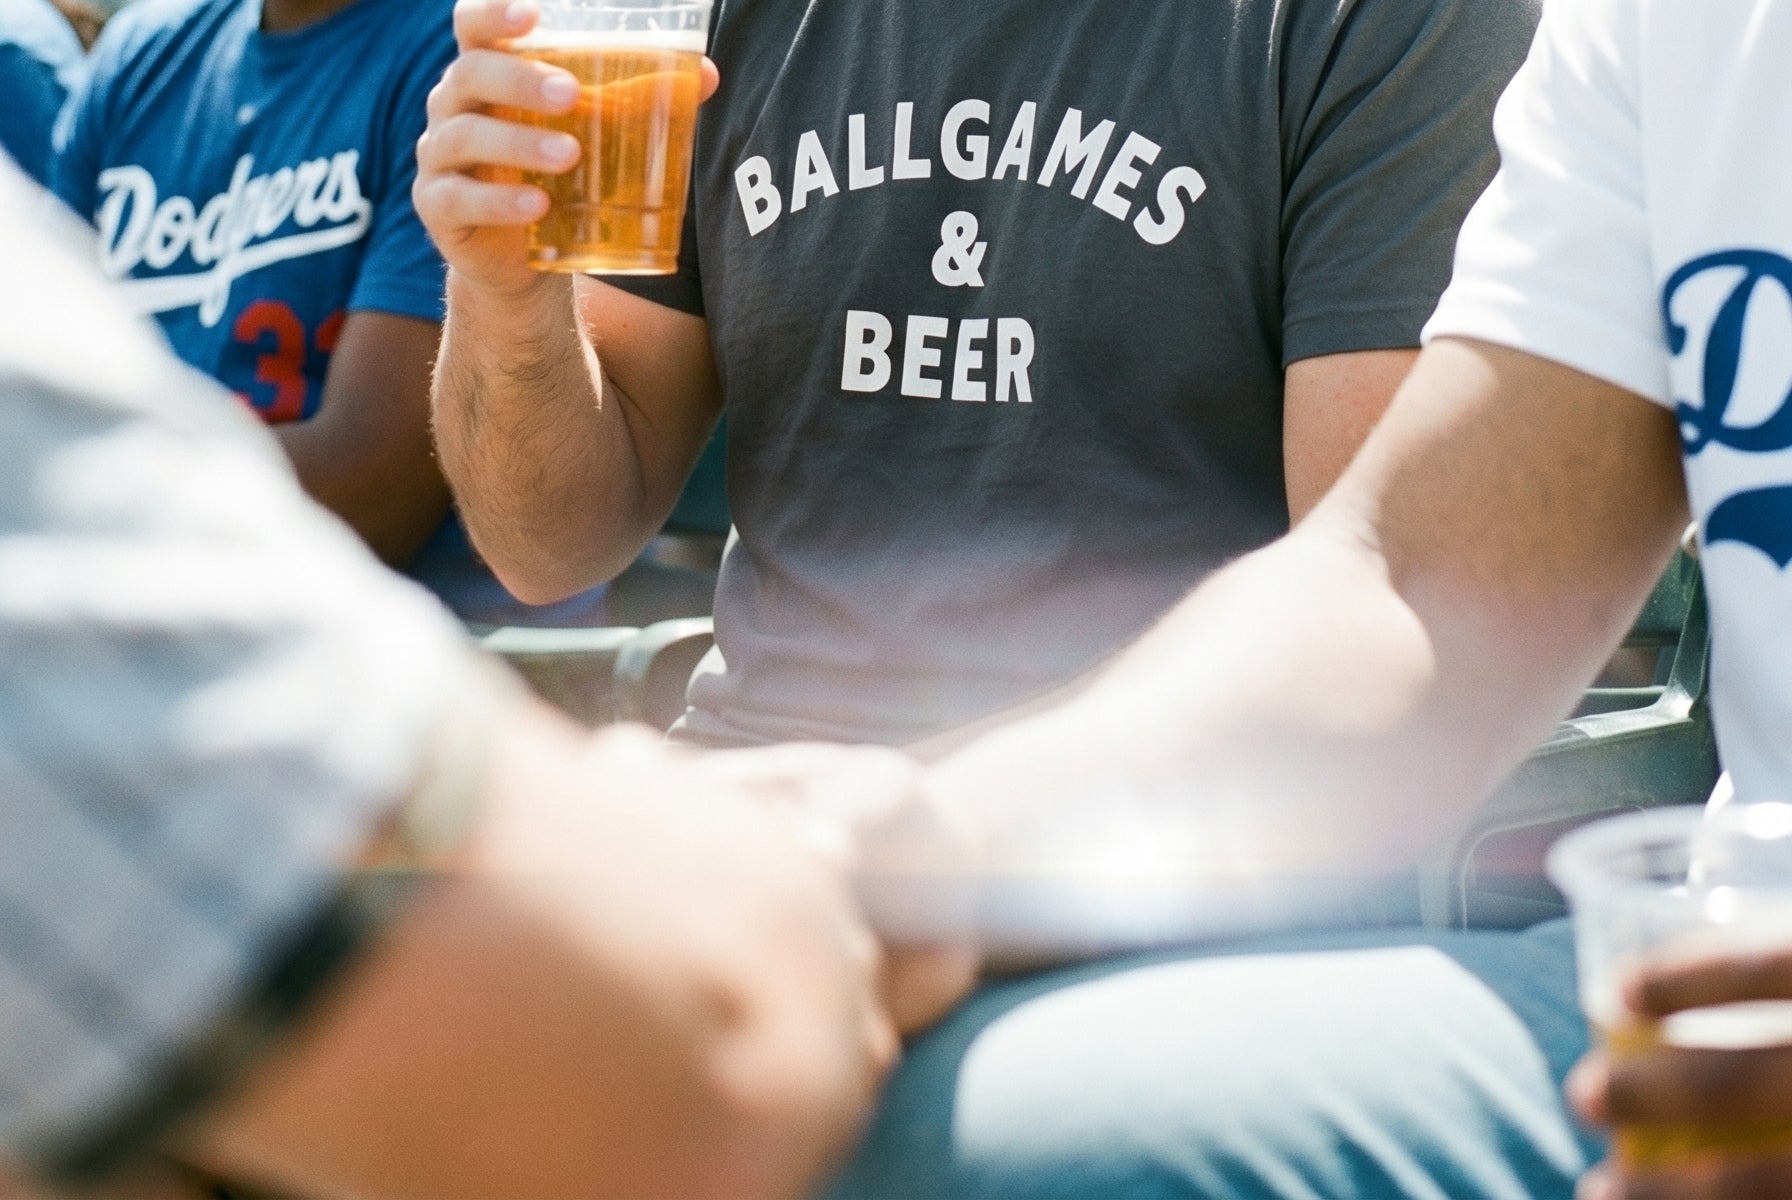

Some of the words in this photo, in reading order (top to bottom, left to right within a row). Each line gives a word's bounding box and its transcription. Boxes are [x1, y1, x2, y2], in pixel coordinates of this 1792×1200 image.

[734, 98, 1207, 246] BALLGAMES
[94, 147, 373, 328] Dodgers
[931, 210, 988, 288] &
[840, 309, 1036, 403] BEER
